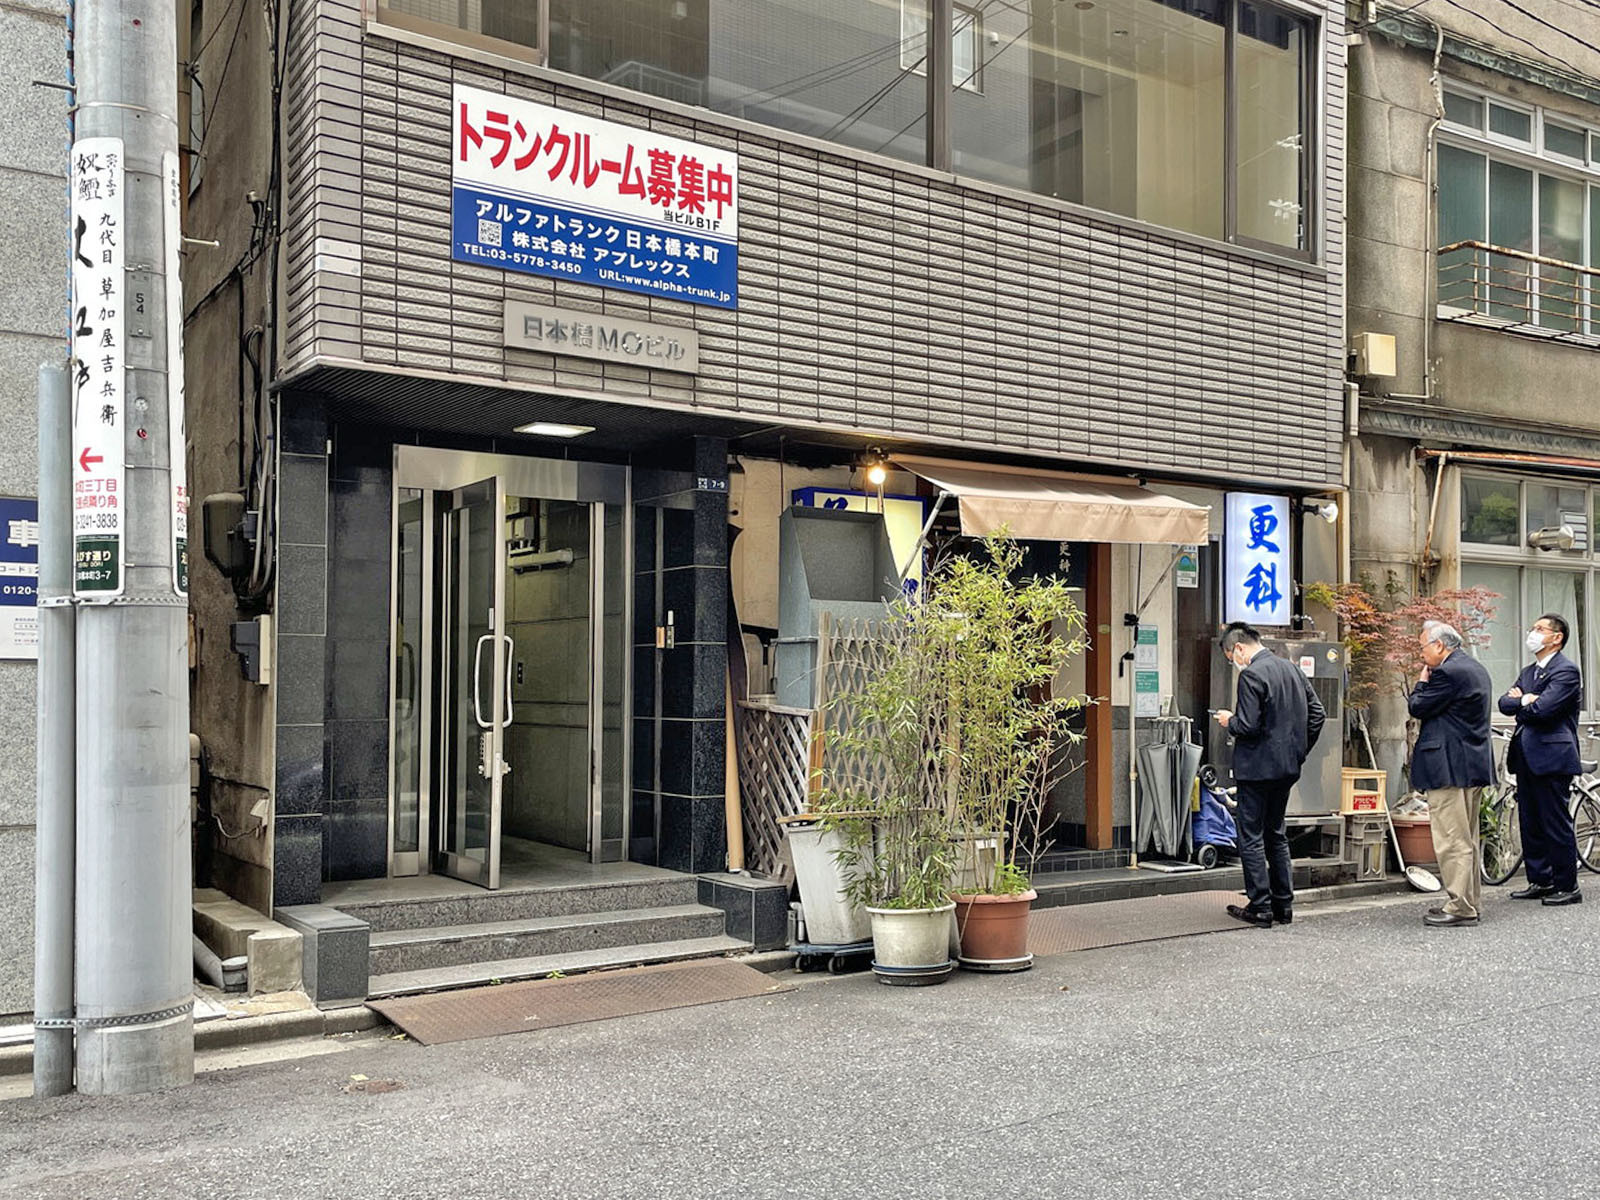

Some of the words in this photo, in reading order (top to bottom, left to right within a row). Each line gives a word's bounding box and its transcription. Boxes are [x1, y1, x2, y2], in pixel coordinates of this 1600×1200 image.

[460, 102, 733, 220] トランクルーム募集中
[99, 212, 117, 265] 九代目
[476, 199, 720, 265] アルファトランク日本橋本町
[663, 209, 721, 231] 当ビルB1F
[462, 242, 582, 274] TEL:03-5778-3450
[511, 230, 587, 260] 株式会社
[598, 268, 731, 302] URL:www.alpha-trunk.jp
[1243, 504, 1283, 613] 更科
